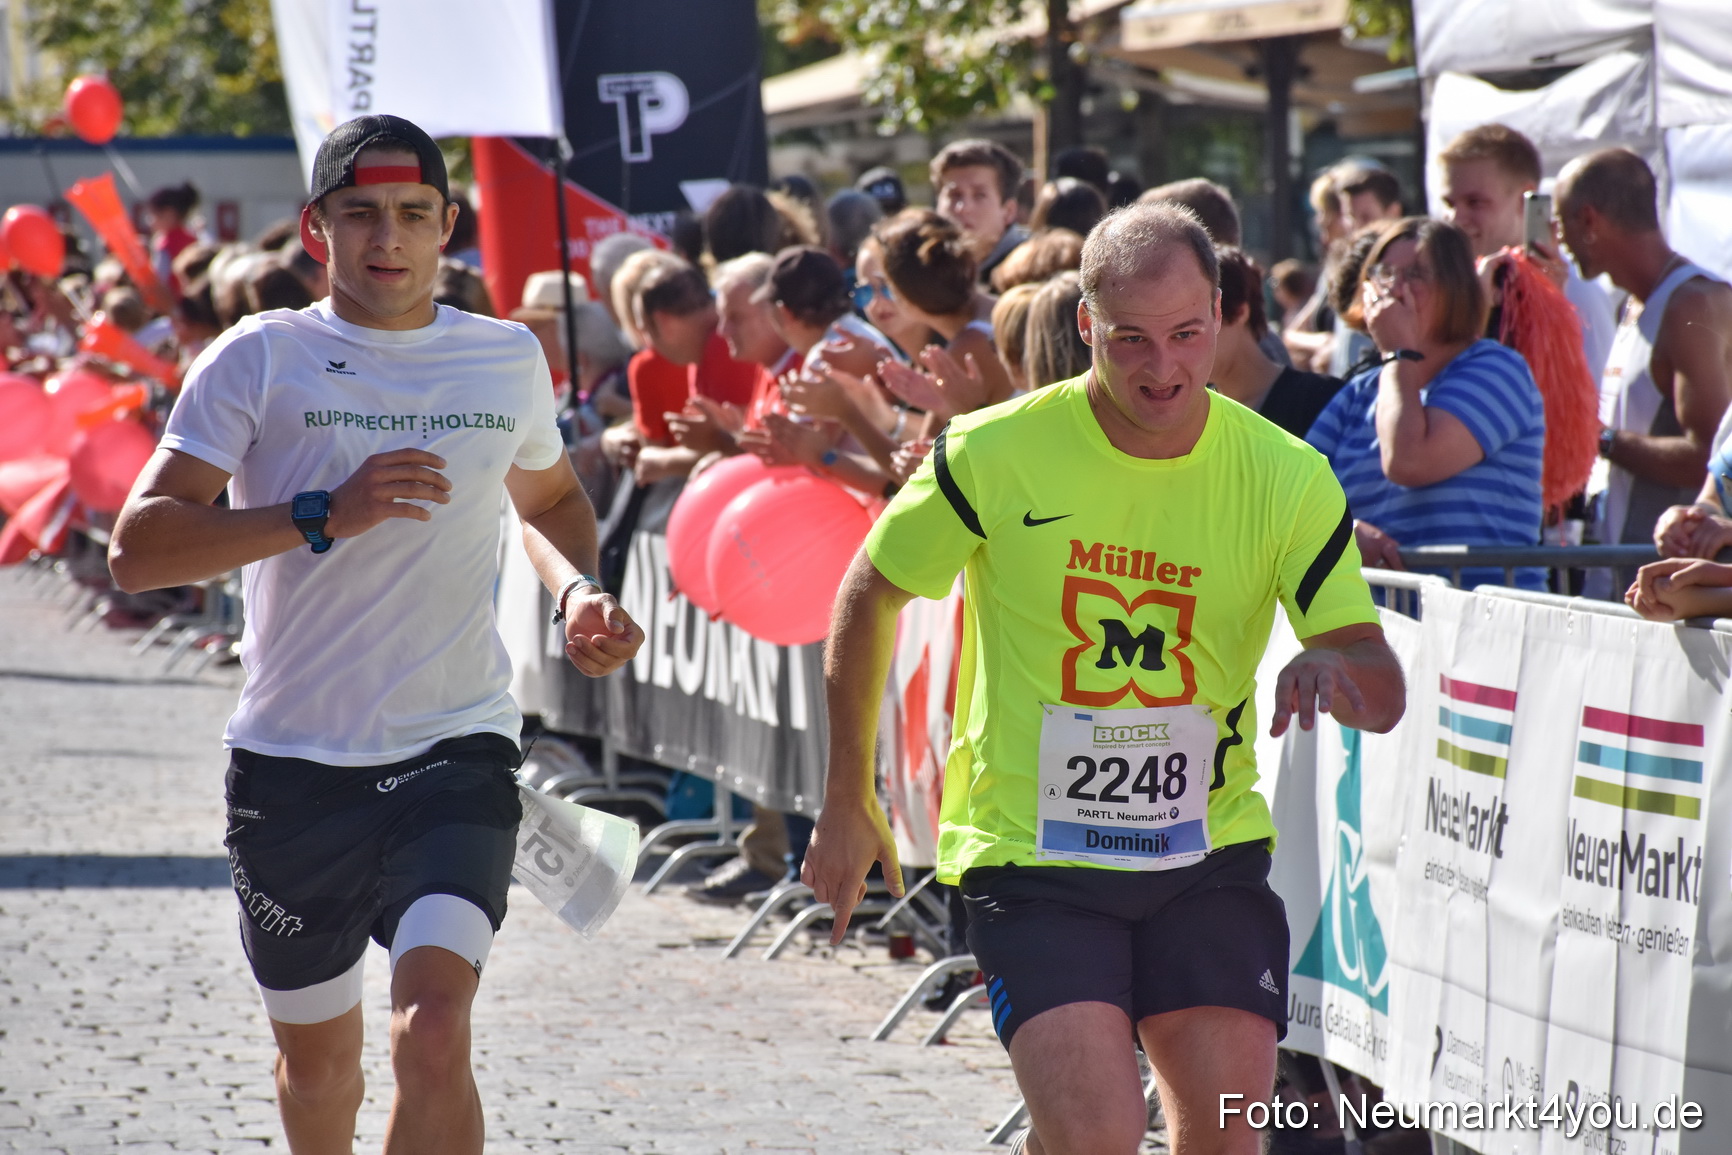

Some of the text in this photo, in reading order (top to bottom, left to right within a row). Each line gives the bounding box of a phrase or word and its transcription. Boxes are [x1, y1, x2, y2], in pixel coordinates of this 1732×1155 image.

[304, 410, 516, 432] RUPPRECHT HOLZBAU
[1066, 539, 1202, 588] Müller
[1095, 619, 1166, 671] M
[1093, 723, 1170, 743] BOCK
[1145, 741, 1171, 749] concepts
[1066, 752, 1188, 804] 2248
[1049, 787, 1056, 797] A
[1077, 808, 1167, 822] PARTL Neumarkt
[1086, 829, 1170, 853] Dominik
[1563, 817, 1702, 907] NeuerMarkt
[1562, 903, 1602, 938] einkaufen
[1637, 925, 1689, 957] genießen
[1259, 979, 1280, 995] adidas
[1288, 994, 1321, 1029] Jura
